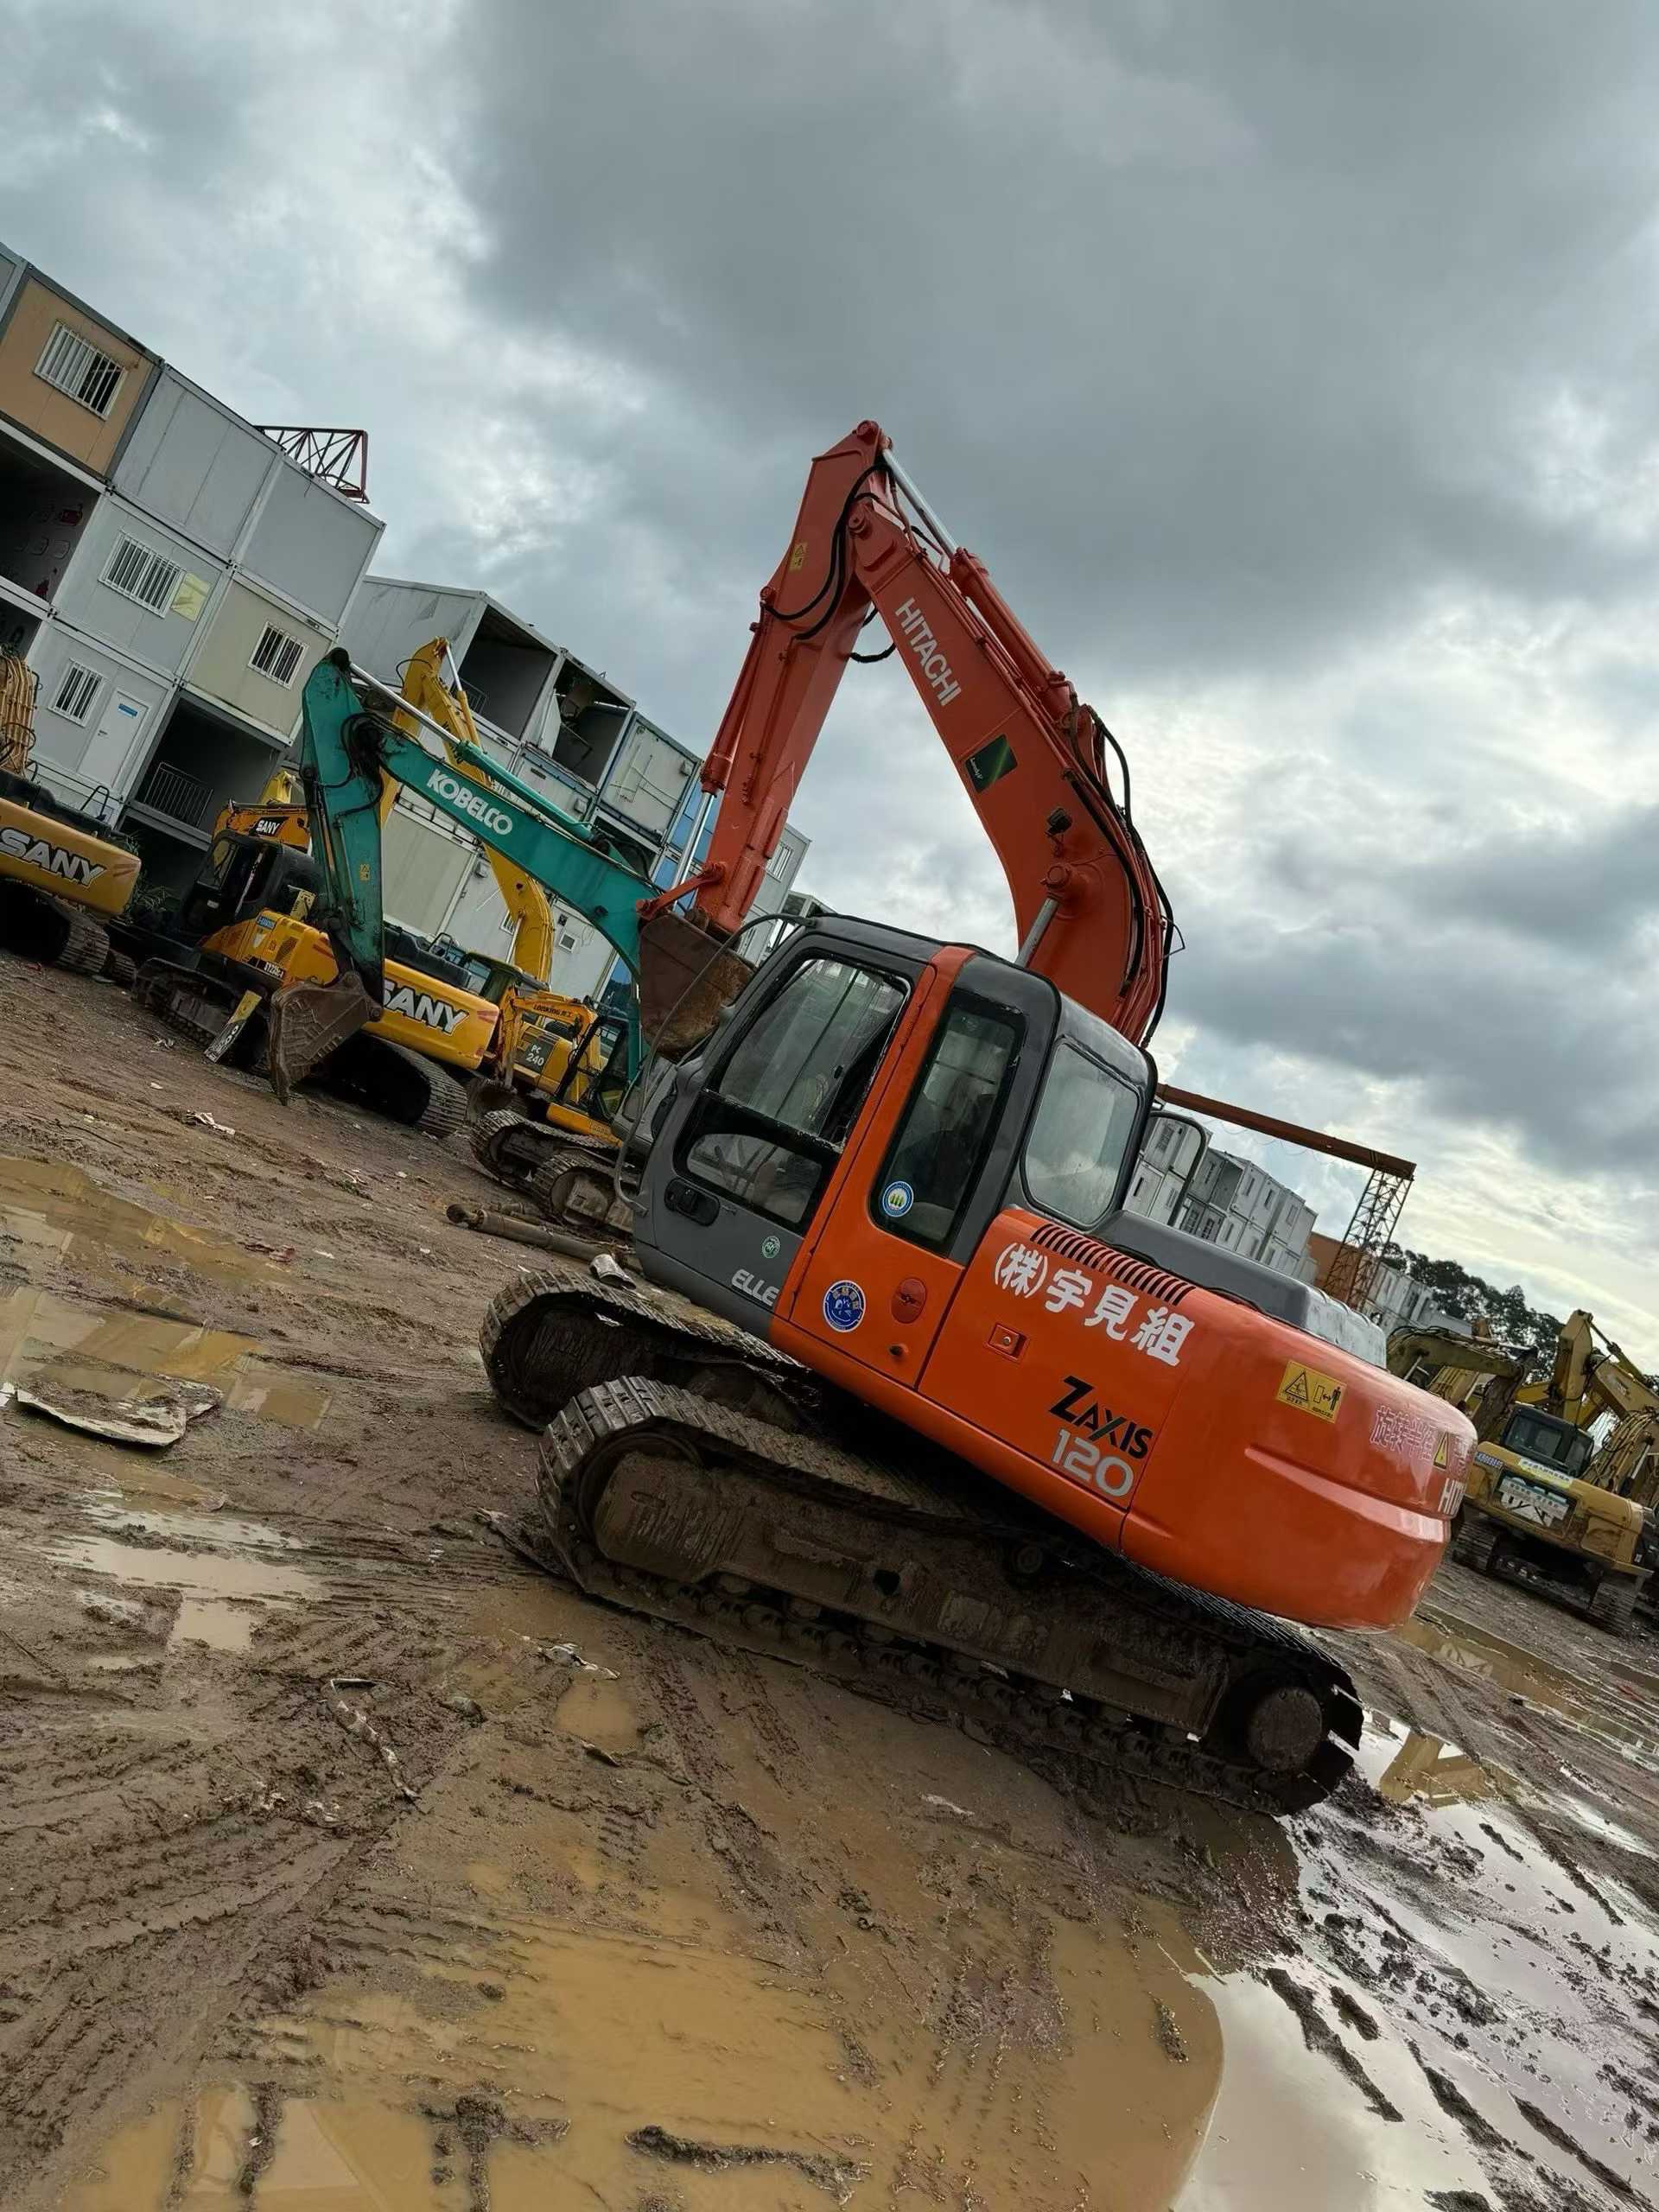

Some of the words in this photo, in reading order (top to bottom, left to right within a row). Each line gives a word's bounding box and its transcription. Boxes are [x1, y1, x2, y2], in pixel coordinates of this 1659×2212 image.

[895, 597, 962, 706] HITACHI
[255, 819, 281, 835] SANY
[427, 768, 513, 836] KOBELCO
[0, 827, 105, 887] SANY
[525, 1052, 545, 1067] 240
[731, 1268, 780, 1306] ELLE
[1048, 1375, 1154, 1460] ZAXIS
[1051, 1428, 1135, 1497] 120
